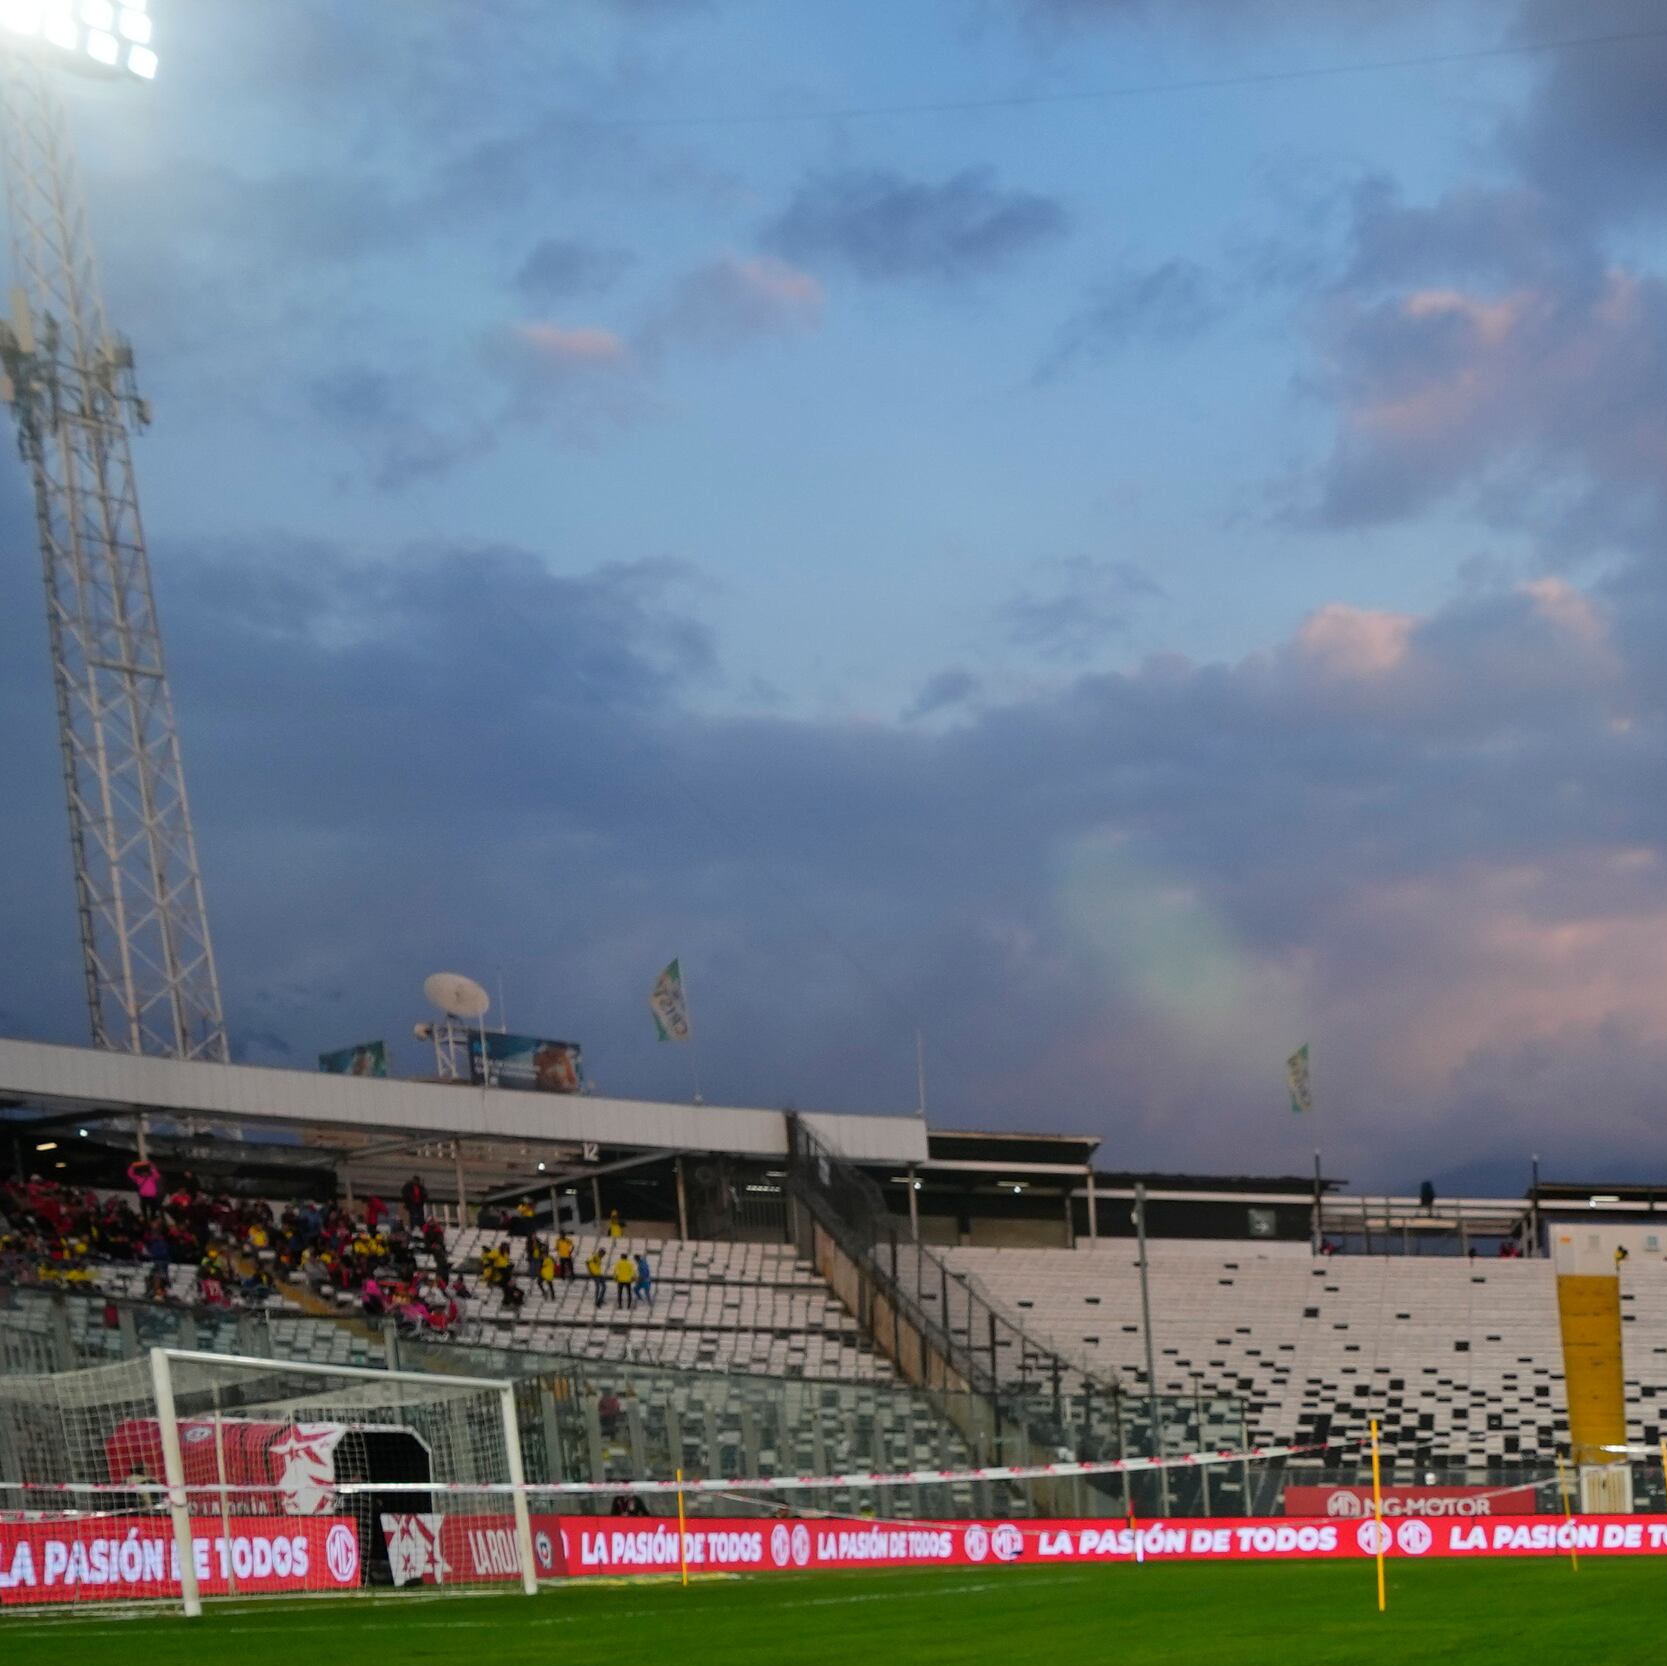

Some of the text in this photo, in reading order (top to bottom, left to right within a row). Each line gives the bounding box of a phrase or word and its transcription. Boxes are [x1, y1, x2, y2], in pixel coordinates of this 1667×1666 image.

[1406, 1498, 1491, 1516] MOTOR
[582, 1525, 762, 1564] LA PASIÓN DE TODOS
[818, 1526, 952, 1560] LA PASIÓN DE TODOS
[1039, 1523, 1337, 1555] LA PASIÓN DE TODOS
[1450, 1526, 1487, 1549] LA
[1493, 1518, 1599, 1549] PASIÓN
[1603, 1524, 1643, 1548] DE
[44, 1527, 164, 1585] PASIÓN
[215, 1536, 309, 1579] TODOS
[328, 1528, 355, 1578] MG
